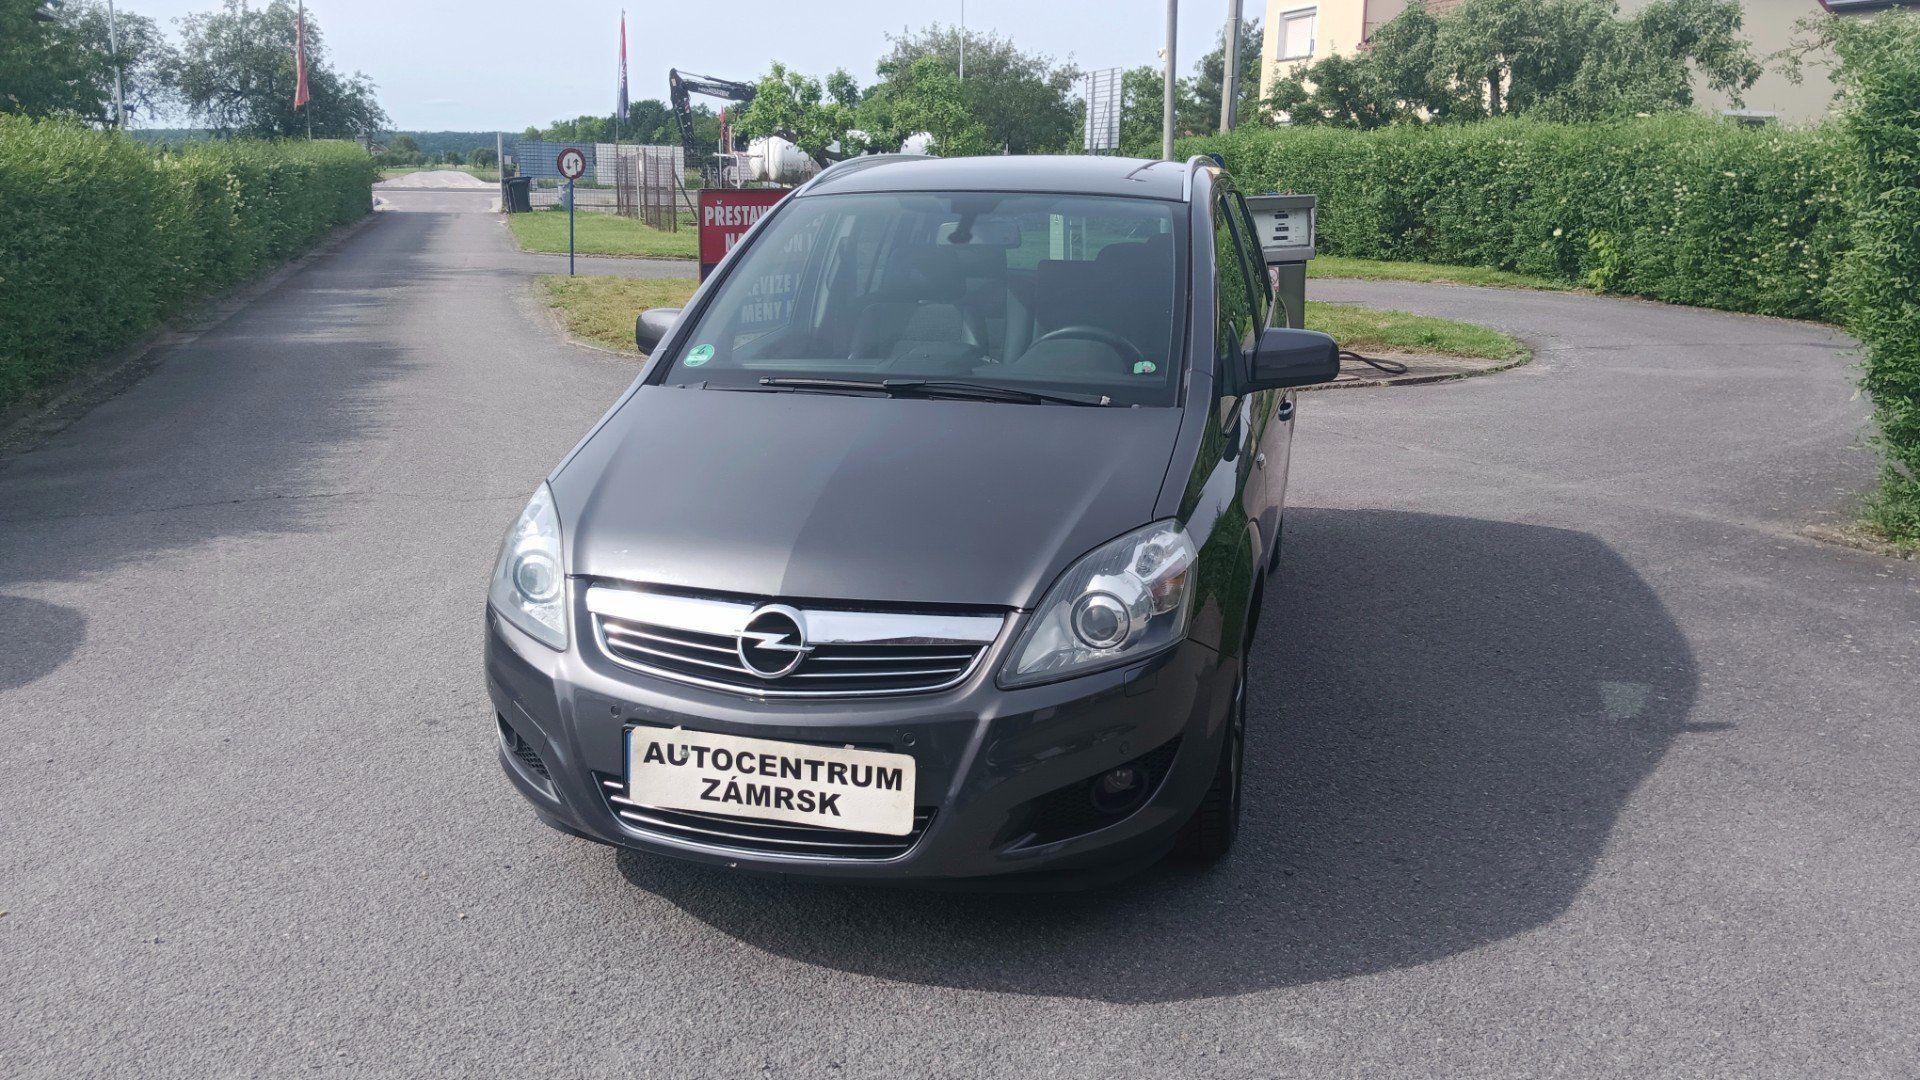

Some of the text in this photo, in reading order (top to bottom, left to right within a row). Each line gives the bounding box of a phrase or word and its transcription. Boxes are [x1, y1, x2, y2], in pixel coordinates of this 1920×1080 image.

[704, 200, 774, 226] PŘESTAV
[741, 297, 782, 323] MĚNY
[643, 741, 903, 791] AUTOCENTRUM
[700, 776, 842, 816] ZÁMRSK
